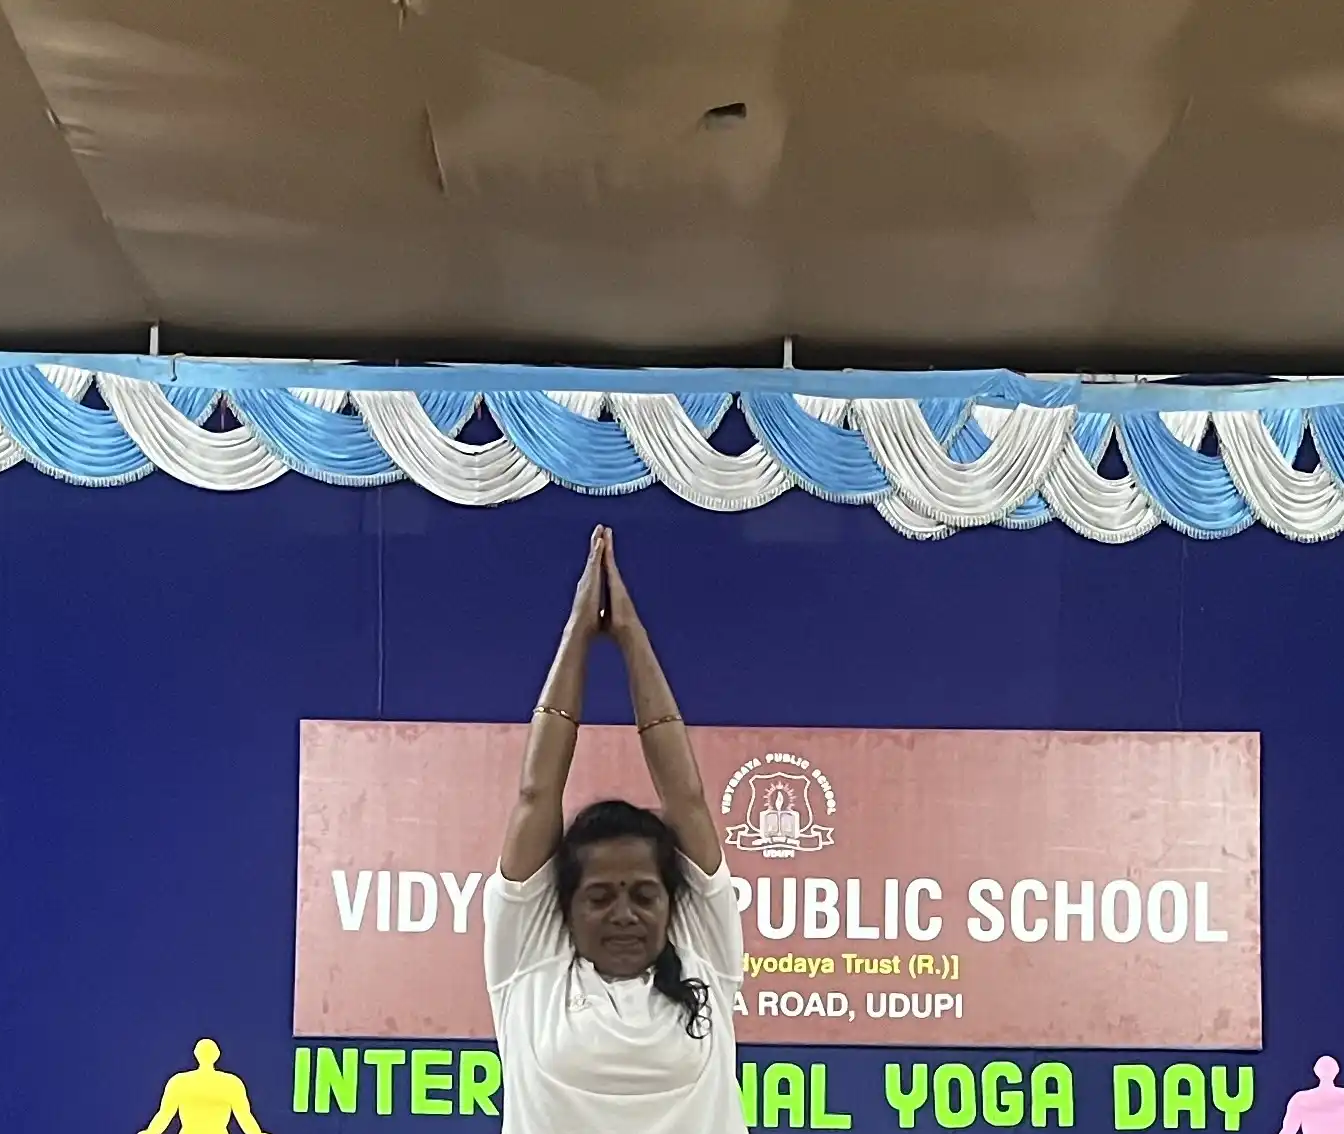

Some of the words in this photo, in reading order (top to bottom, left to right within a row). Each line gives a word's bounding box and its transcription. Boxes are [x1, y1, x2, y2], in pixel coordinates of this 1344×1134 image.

[765, 752, 810, 770] PUBLIC
[811, 768, 837, 816] SCHOOL
[762, 848, 795, 858] UDUPI
[966, 877, 1229, 944] SCHOOL
[842, 953, 901, 975] Trust
[908, 954, 960, 980] (R.)]
[758, 990, 856, 1022] ROAD,
[866, 992, 964, 1019] UDUPI
[885, 1061, 1075, 1129] YOGA
[1112, 1062, 1255, 1132] DAY
